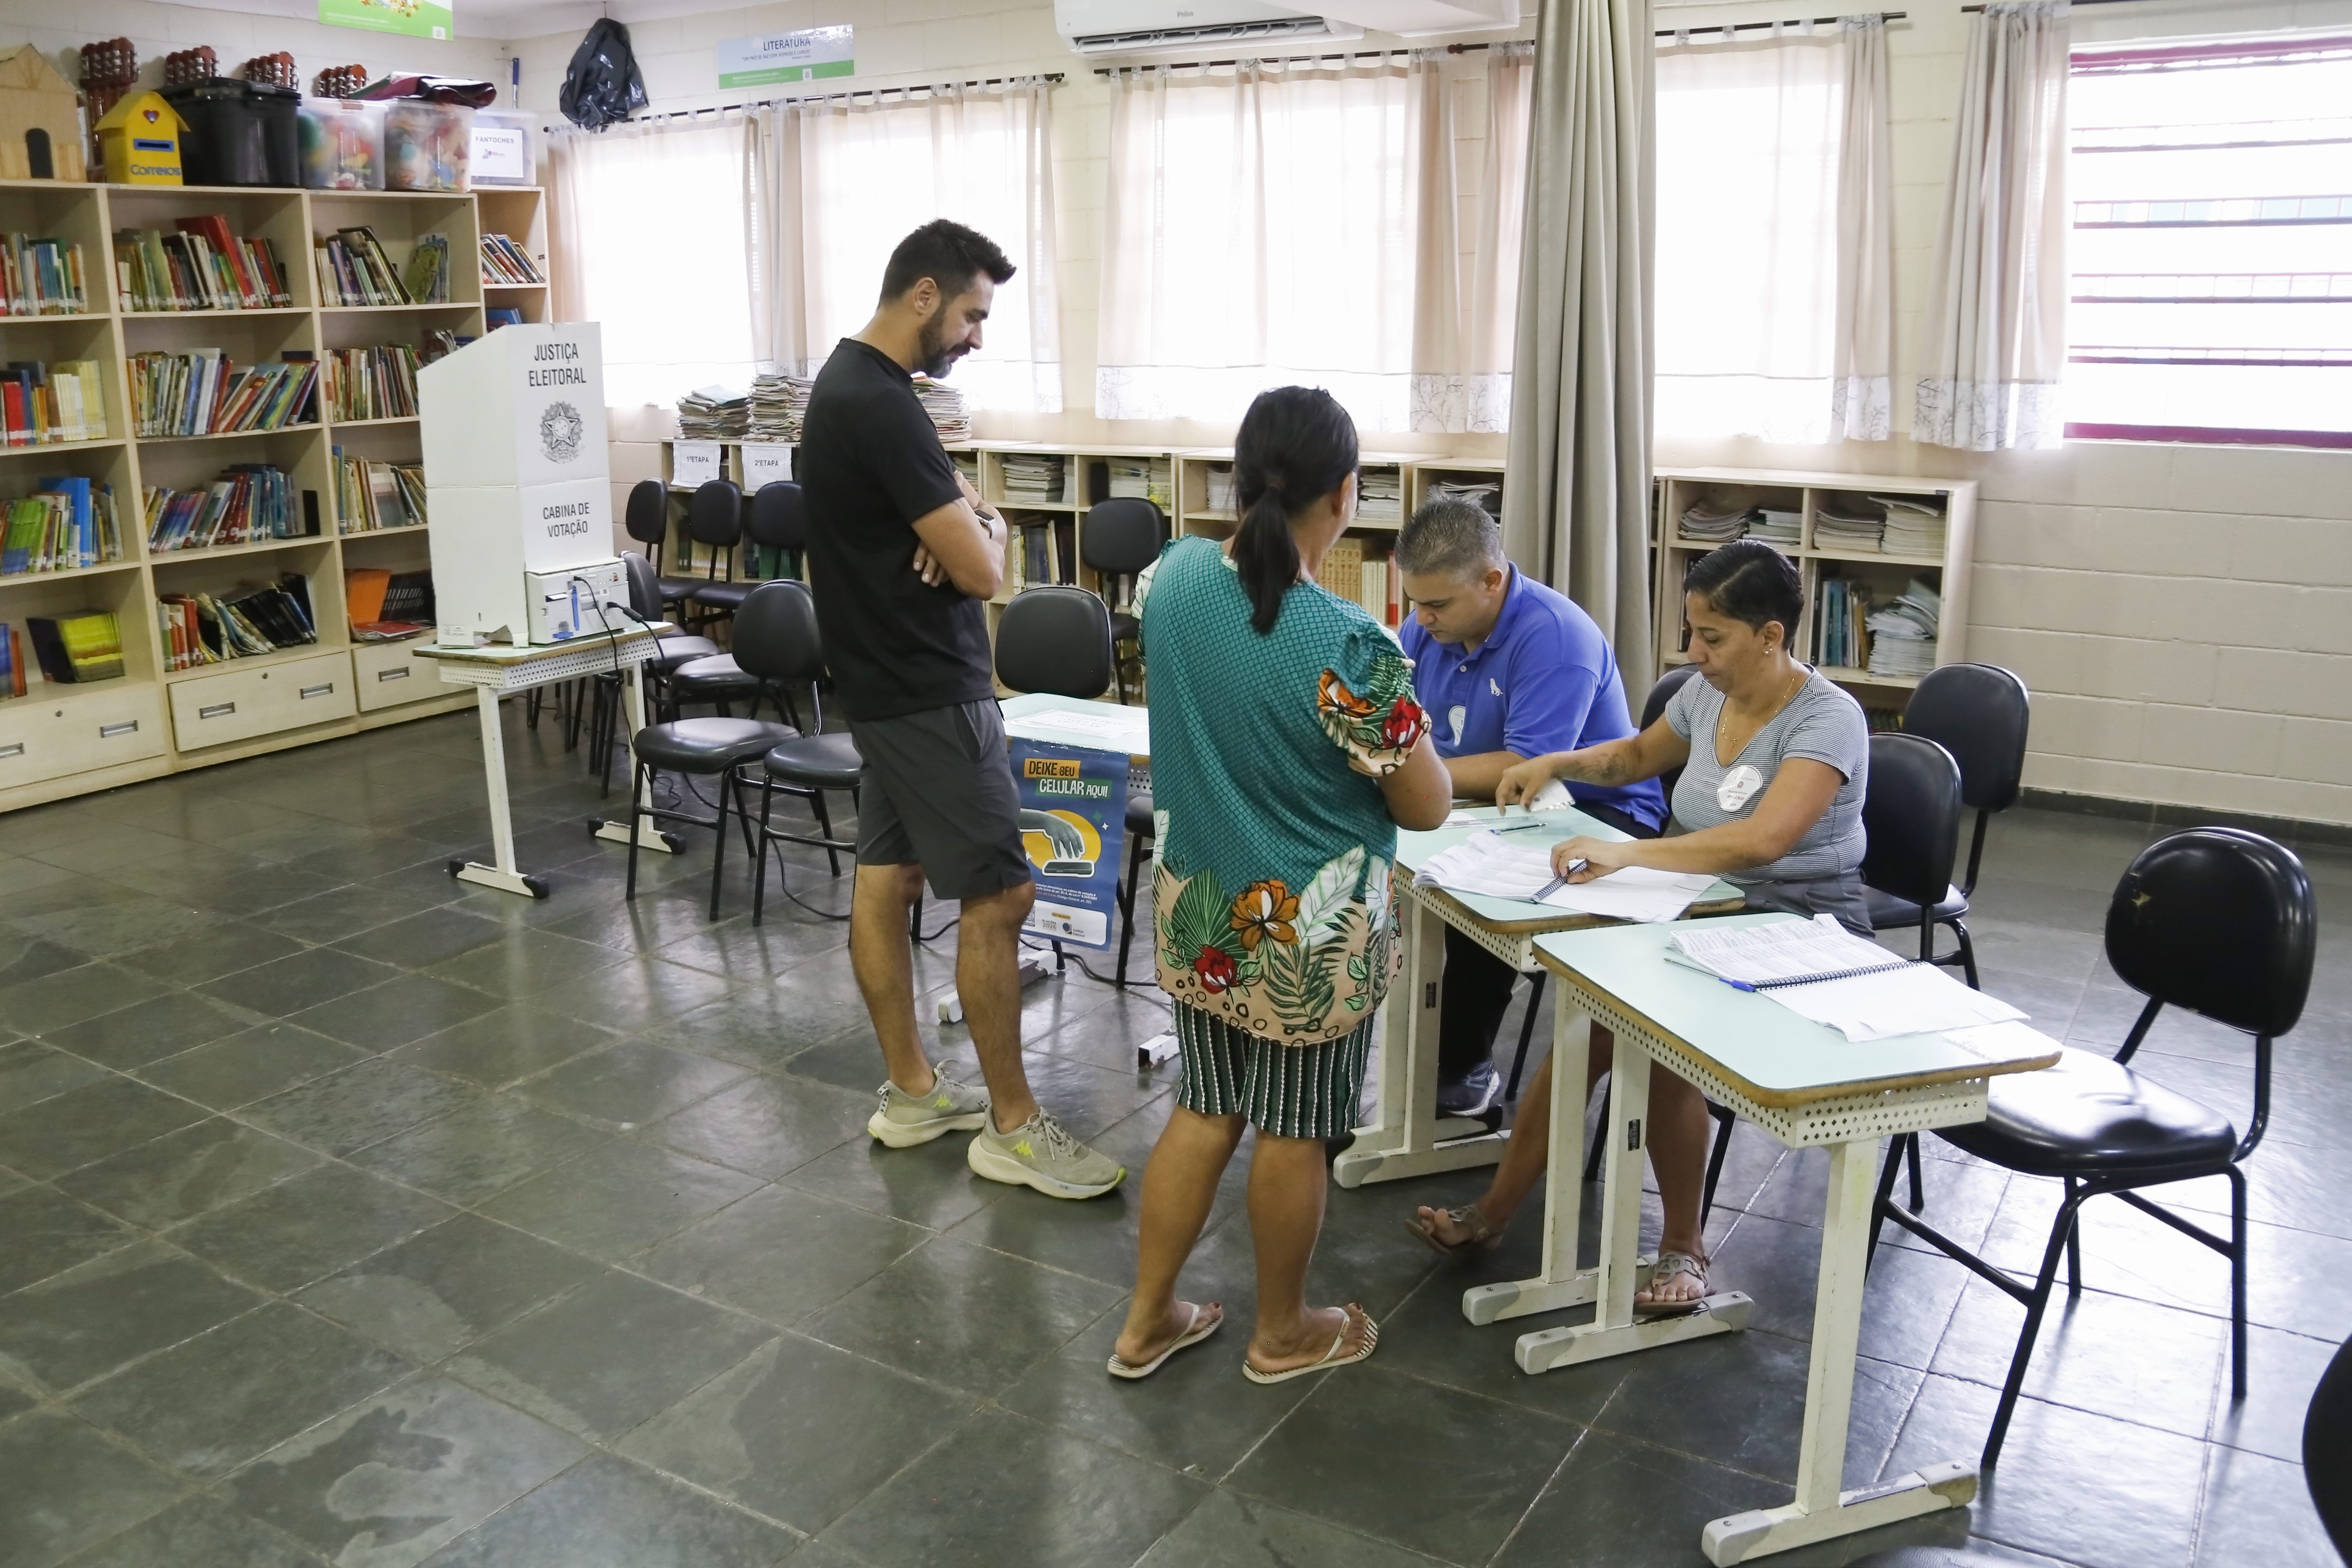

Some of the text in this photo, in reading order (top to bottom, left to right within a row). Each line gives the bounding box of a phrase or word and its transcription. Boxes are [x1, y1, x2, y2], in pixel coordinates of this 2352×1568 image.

[763, 37, 811, 51] LITERATURA
[131, 164, 182, 176] Correios
[534, 343, 579, 364] JUSTIÇA
[529, 367, 586, 386] ELEITORAL
[543, 502, 590, 519] CABINA DE
[547, 519, 588, 538] VOTAÇÃO
[1029, 761, 1075, 777] DEIXE SEU
[1039, 778, 1108, 798] CELULAR AQUI!
